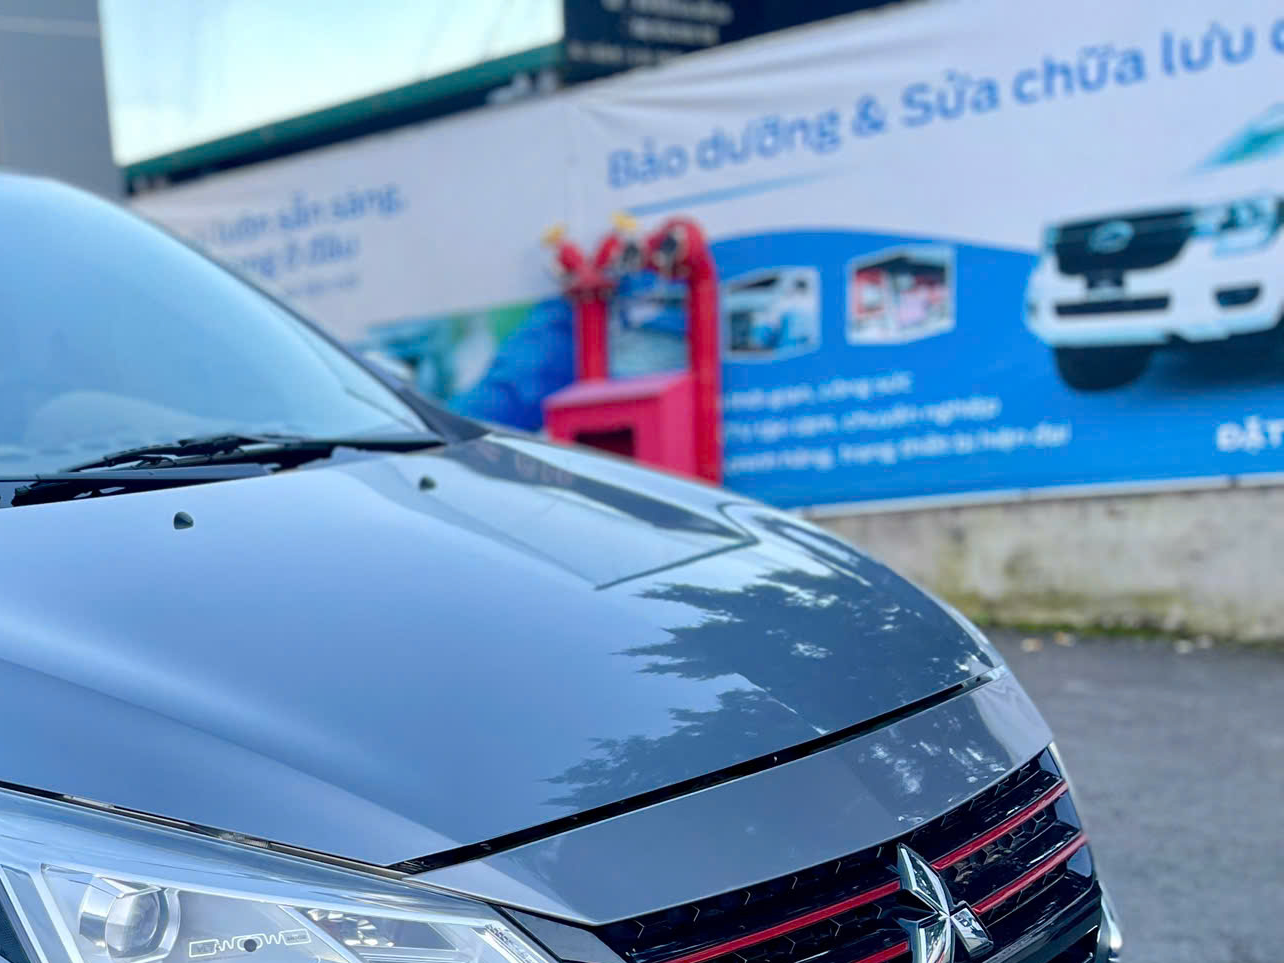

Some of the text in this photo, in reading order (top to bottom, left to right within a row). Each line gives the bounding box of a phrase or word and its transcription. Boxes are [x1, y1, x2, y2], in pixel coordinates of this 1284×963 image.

[608, 138, 690, 190] Bảo
[695, 109, 842, 172] dưỡng
[851, 94, 887, 138] &
[900, 68, 1000, 128] Sửa
[1011, 42, 1147, 105] chữa
[1160, 20, 1256, 76] lưu
